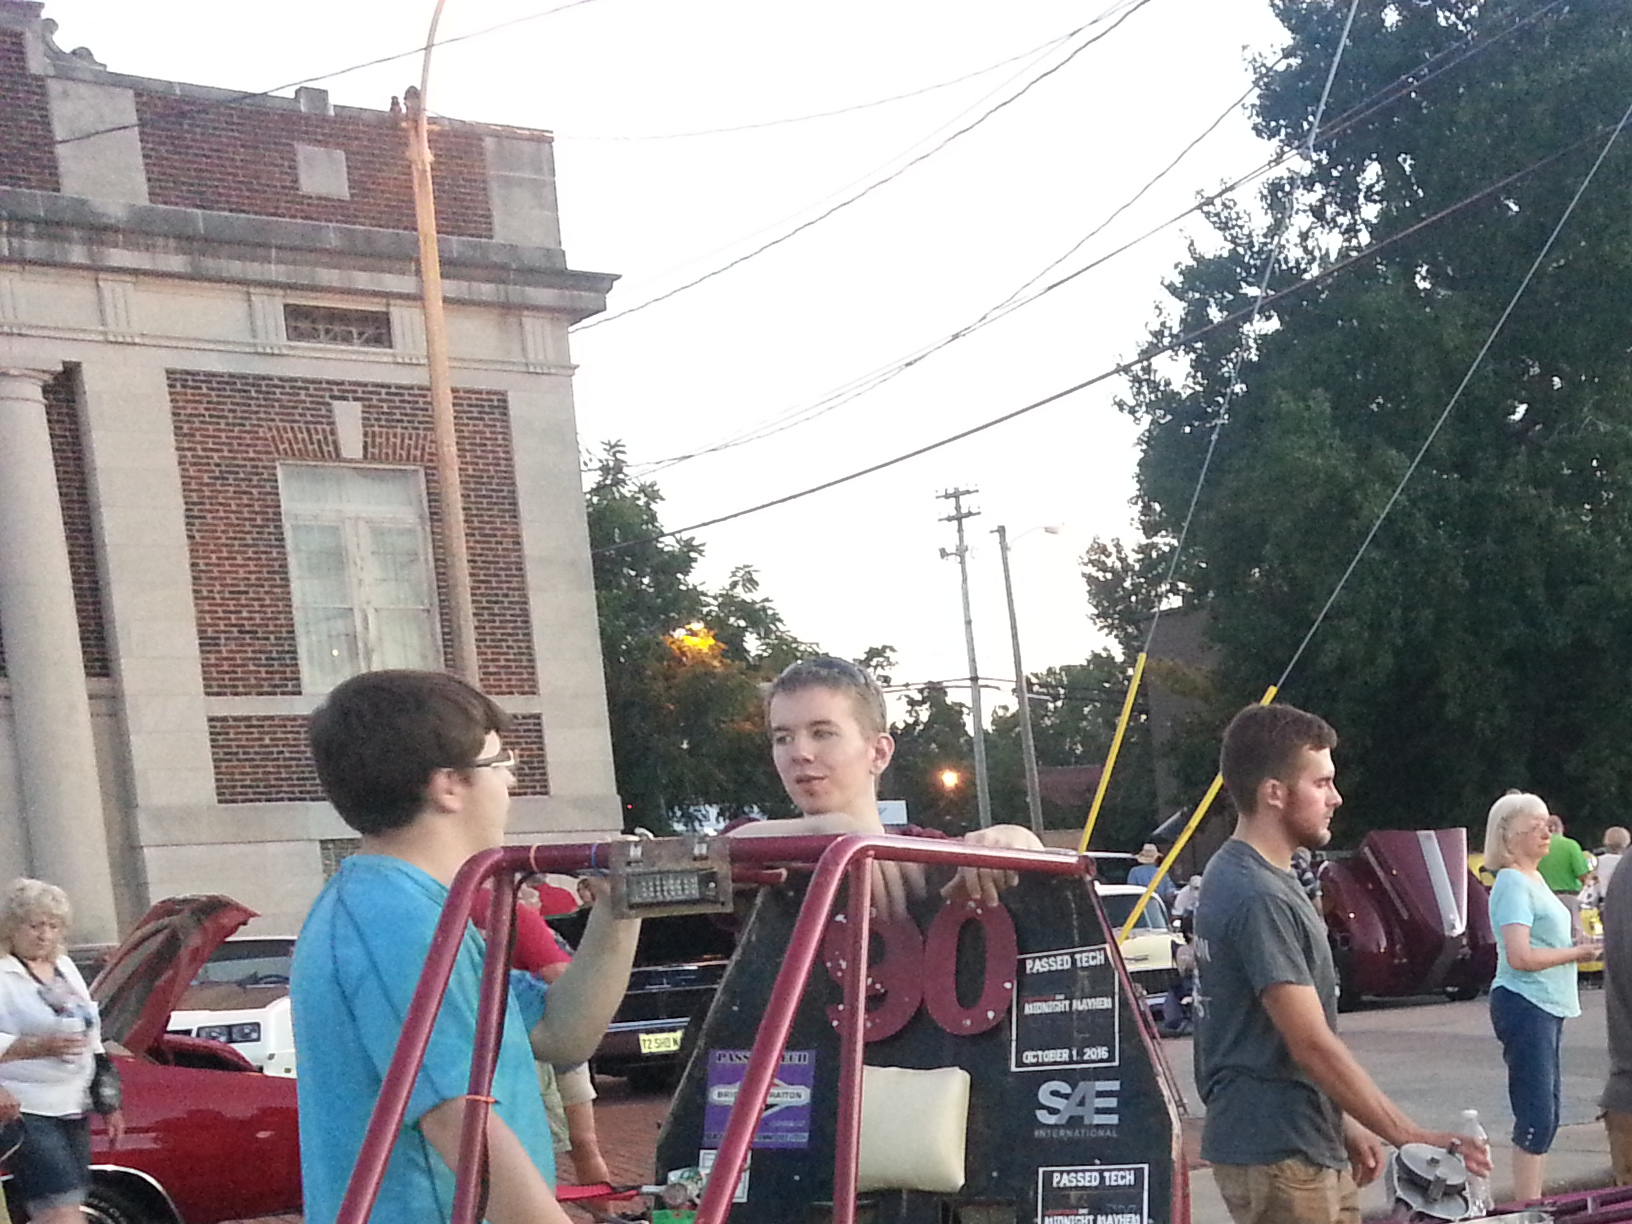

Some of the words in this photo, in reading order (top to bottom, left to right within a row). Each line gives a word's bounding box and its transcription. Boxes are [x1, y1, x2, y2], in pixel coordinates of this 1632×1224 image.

[823, 899, 1018, 1042] 90
[1025, 953, 1072, 974] PASSED
[1074, 949, 1106, 968] TECH
[1024, 999, 1070, 1015] MIDNIGHT
[1072, 996, 1112, 1011] MAYHEM
[1022, 1048, 1070, 1064] OCTOBER
[1035, 1079, 1121, 1125] SAE
[1052, 1171, 1100, 1187] PASSED
[1103, 1170, 1135, 1186] TECH
